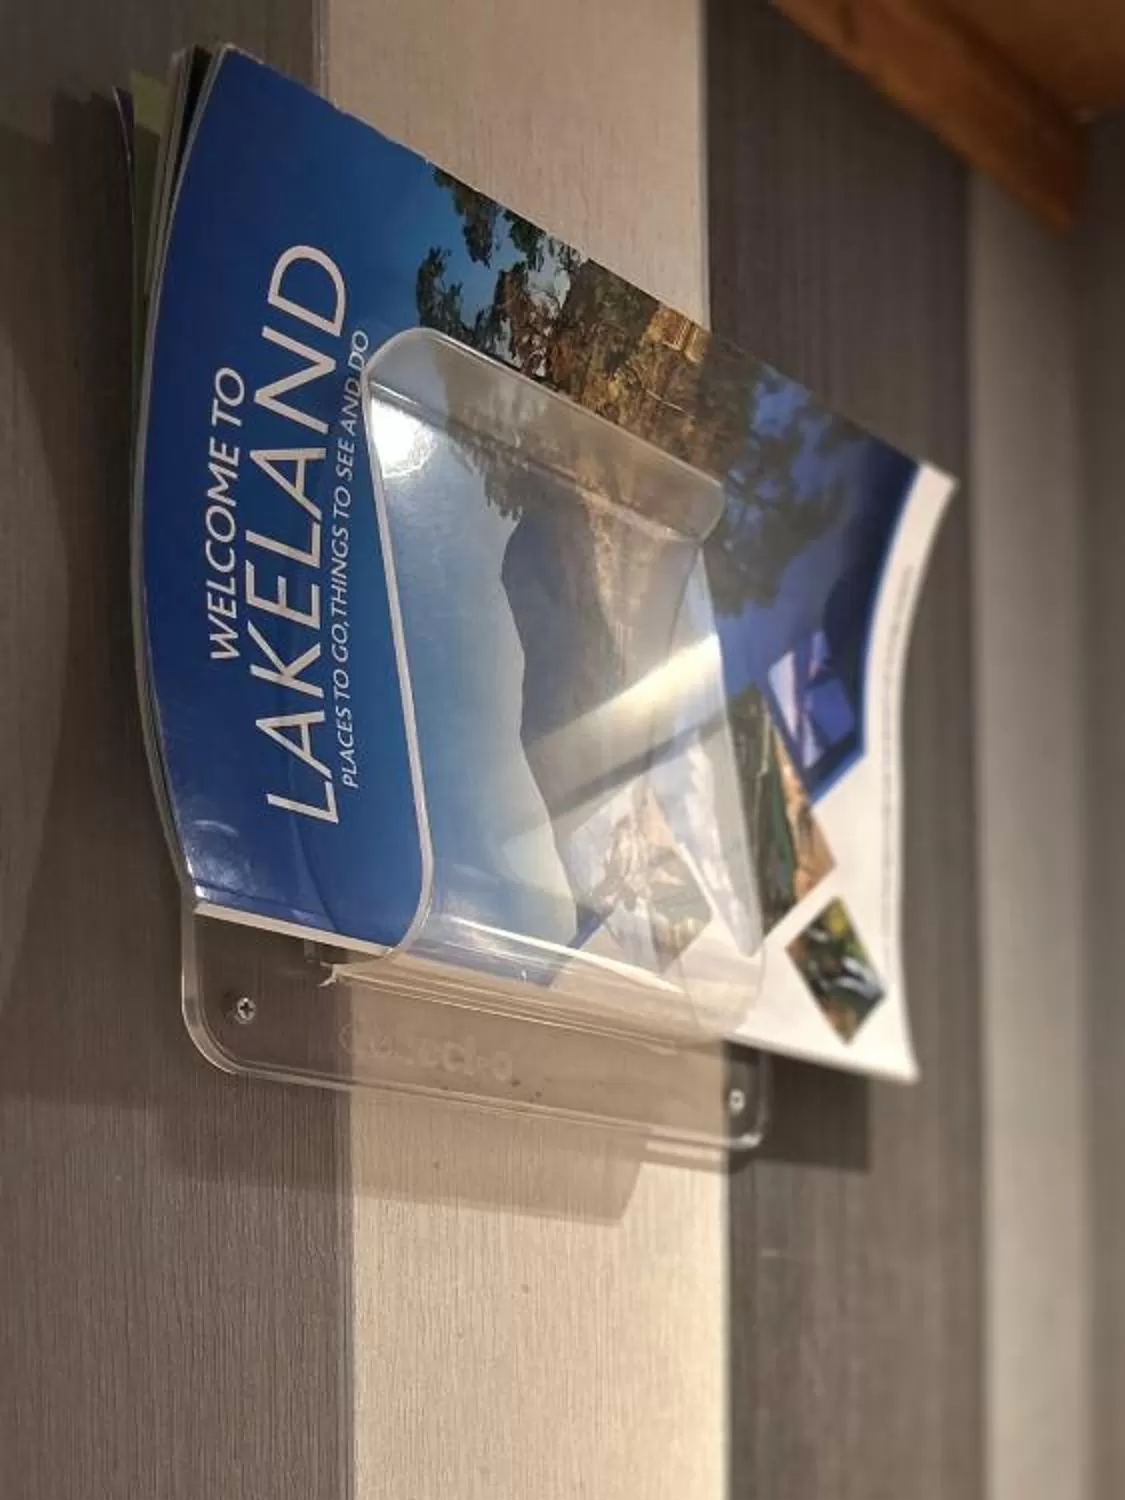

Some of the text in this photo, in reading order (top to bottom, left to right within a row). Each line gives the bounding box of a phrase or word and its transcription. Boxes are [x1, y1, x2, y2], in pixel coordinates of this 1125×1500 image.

[348, 331, 369, 371] DO
[341, 377, 361, 437] AND
[336, 438, 355, 481] SEE
[205, 367, 245, 660] WELCOME TO
[333, 486, 351, 519] TO
[245, 245, 346, 825] LAKELAND
[333, 668, 350, 700] TO
[335, 705, 359, 789] PLACES
